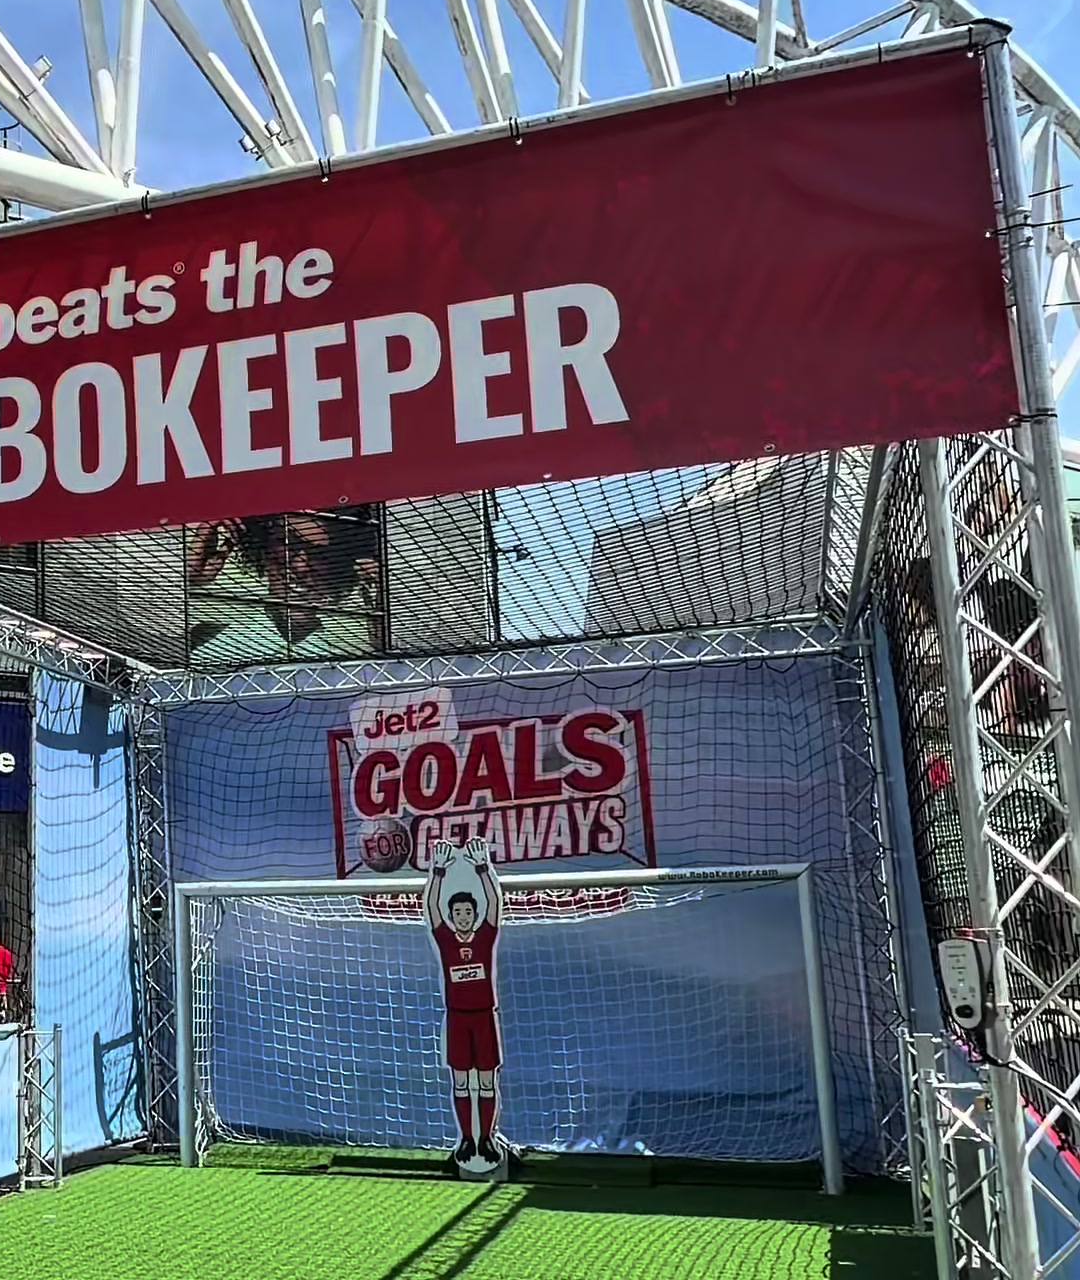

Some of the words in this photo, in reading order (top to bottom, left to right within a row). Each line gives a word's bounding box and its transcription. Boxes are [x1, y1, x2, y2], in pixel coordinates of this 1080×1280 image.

[200, 241, 334, 313] the
[363, 700, 440, 740] Jet2
[353, 711, 625, 818] GOALS
[362, 832, 408, 857] FOR
